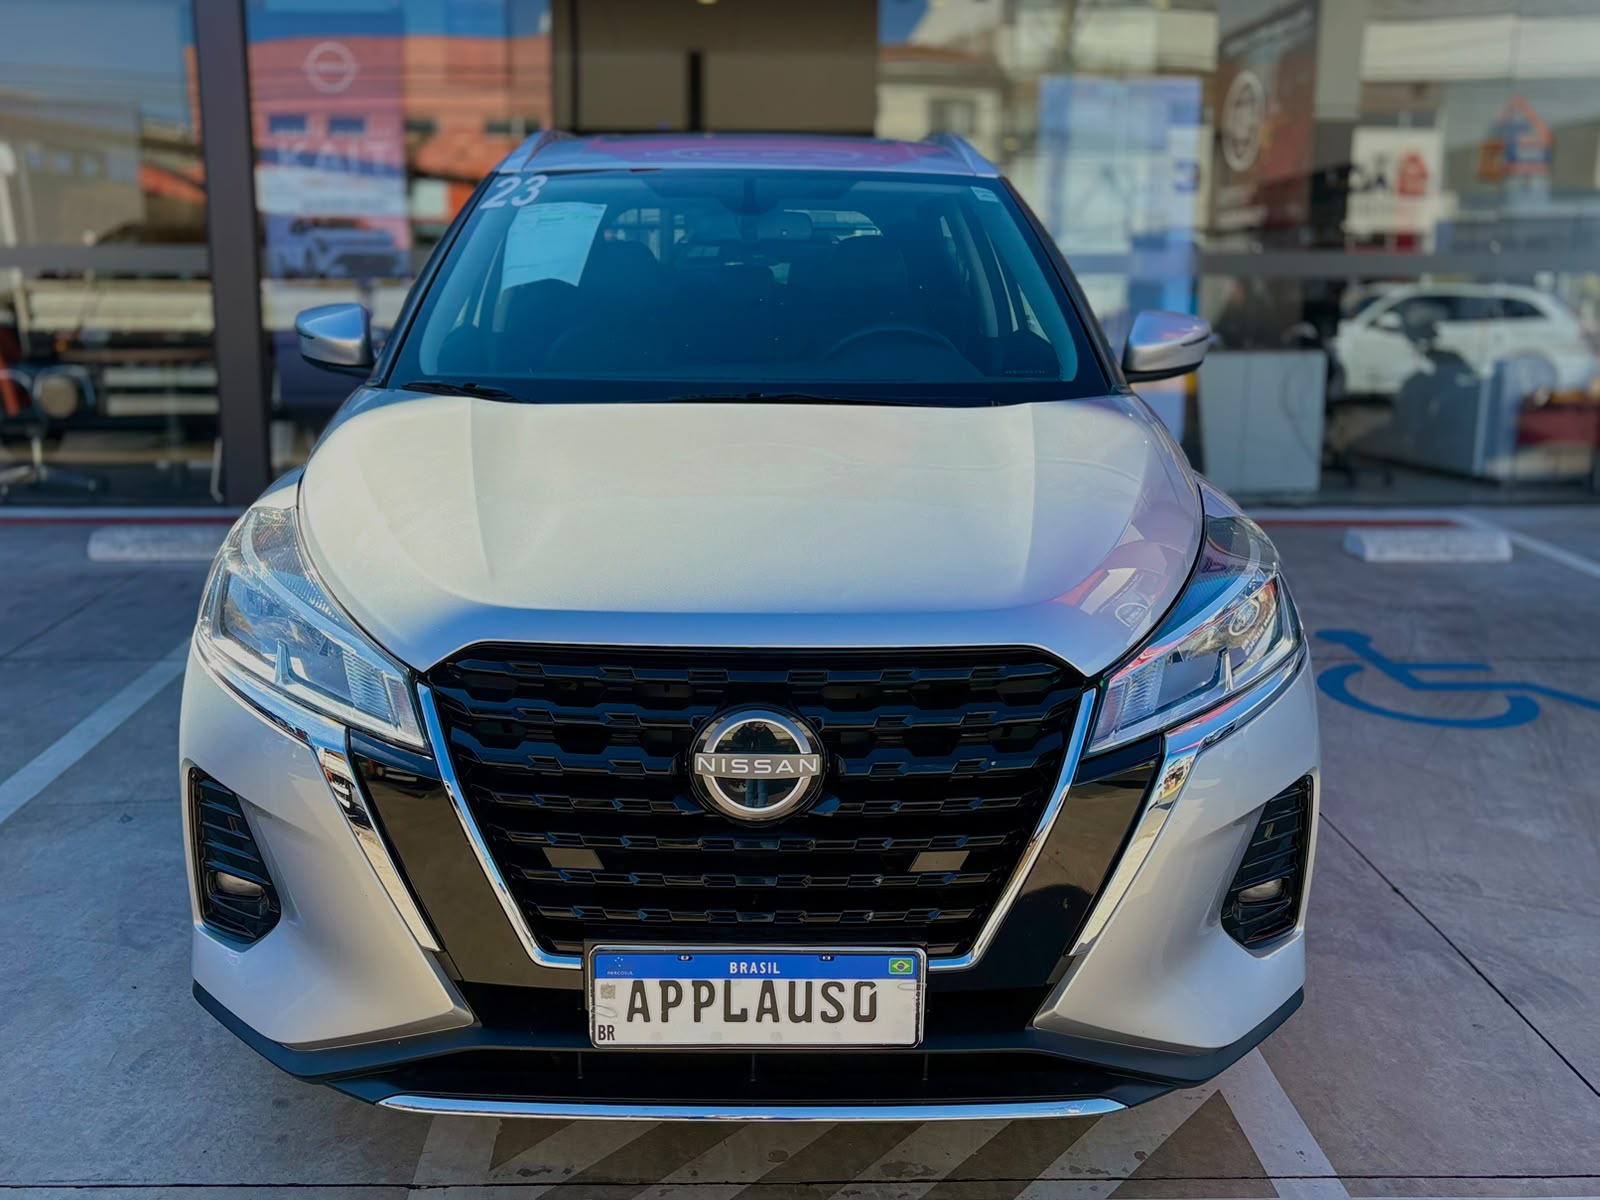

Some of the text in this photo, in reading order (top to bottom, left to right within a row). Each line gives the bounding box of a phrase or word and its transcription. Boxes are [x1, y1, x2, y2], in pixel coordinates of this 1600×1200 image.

[480, 174, 548, 210] 23
[697, 756, 818, 774] NISSAN
[729, 962, 781, 974] BRASIL
[626, 979, 878, 1024] APPLAUSO
[597, 1024, 616, 1041] BR
